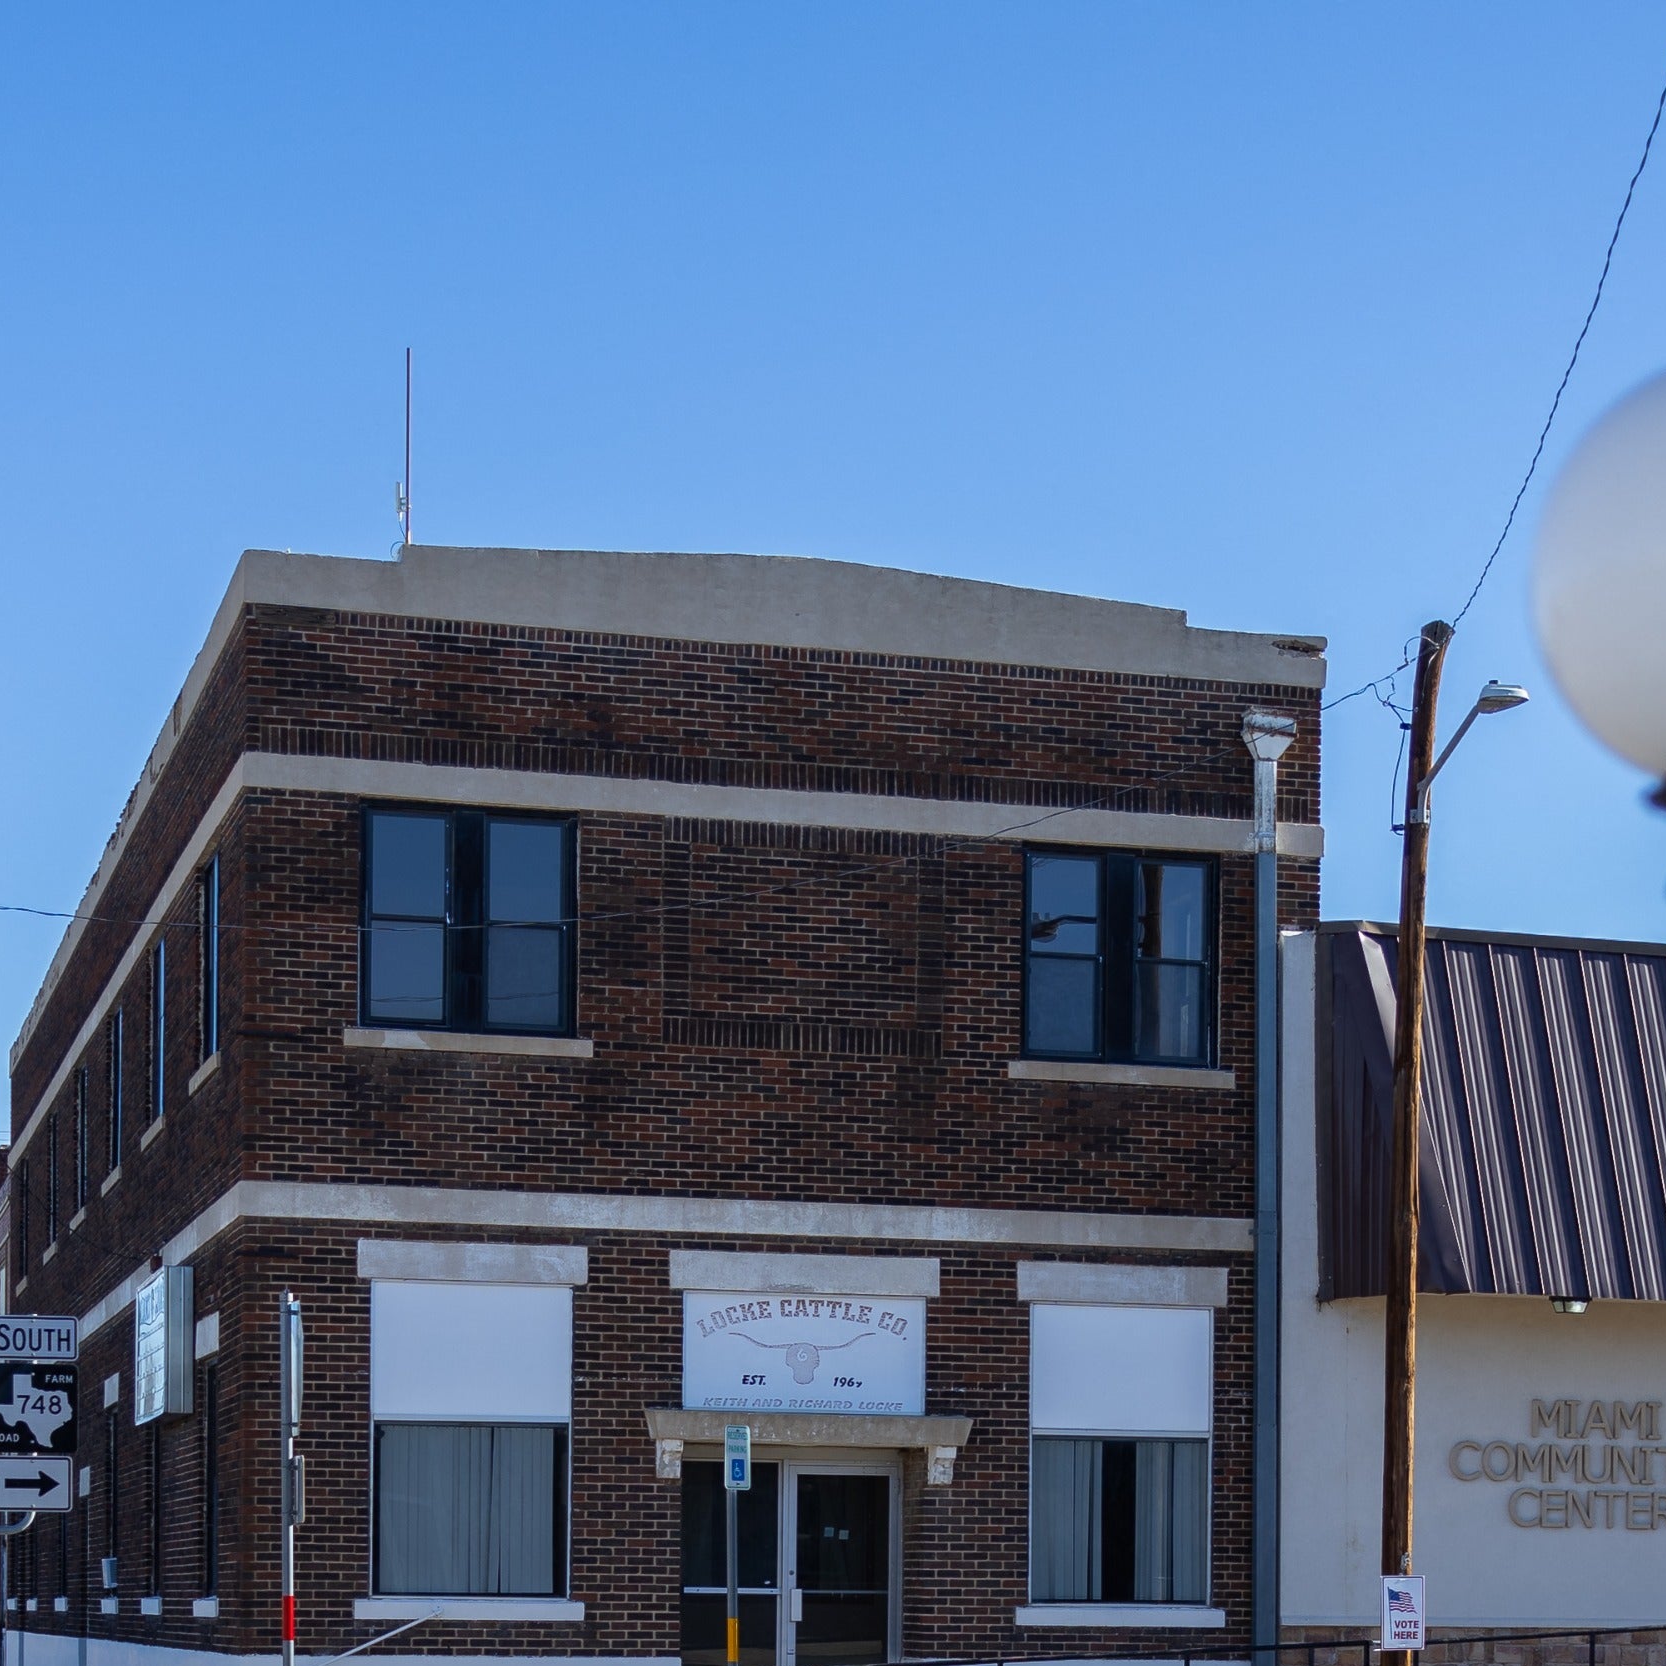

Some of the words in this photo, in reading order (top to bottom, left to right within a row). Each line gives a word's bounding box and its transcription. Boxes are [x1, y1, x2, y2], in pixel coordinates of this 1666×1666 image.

[696, 1300, 773, 1338] LOCKE
[779, 1299, 873, 1325] CATTLE
[877, 1311, 909, 1341] CO.
[45, 1374, 74, 1384] FARM
[741, 1374, 767, 1386] EST.
[16, 1394, 62, 1415] 748
[703, 1397, 749, 1407] KEITH
[752, 1398, 783, 1408] AND
[788, 1399, 853, 1410] RICHARD
[858, 1401, 904, 1412] LOCKE
[1530, 1398, 1663, 1440] MIAMI
[1394, 1620, 1420, 1629] VOTE
[1393, 1631, 1419, 1640] HERE
